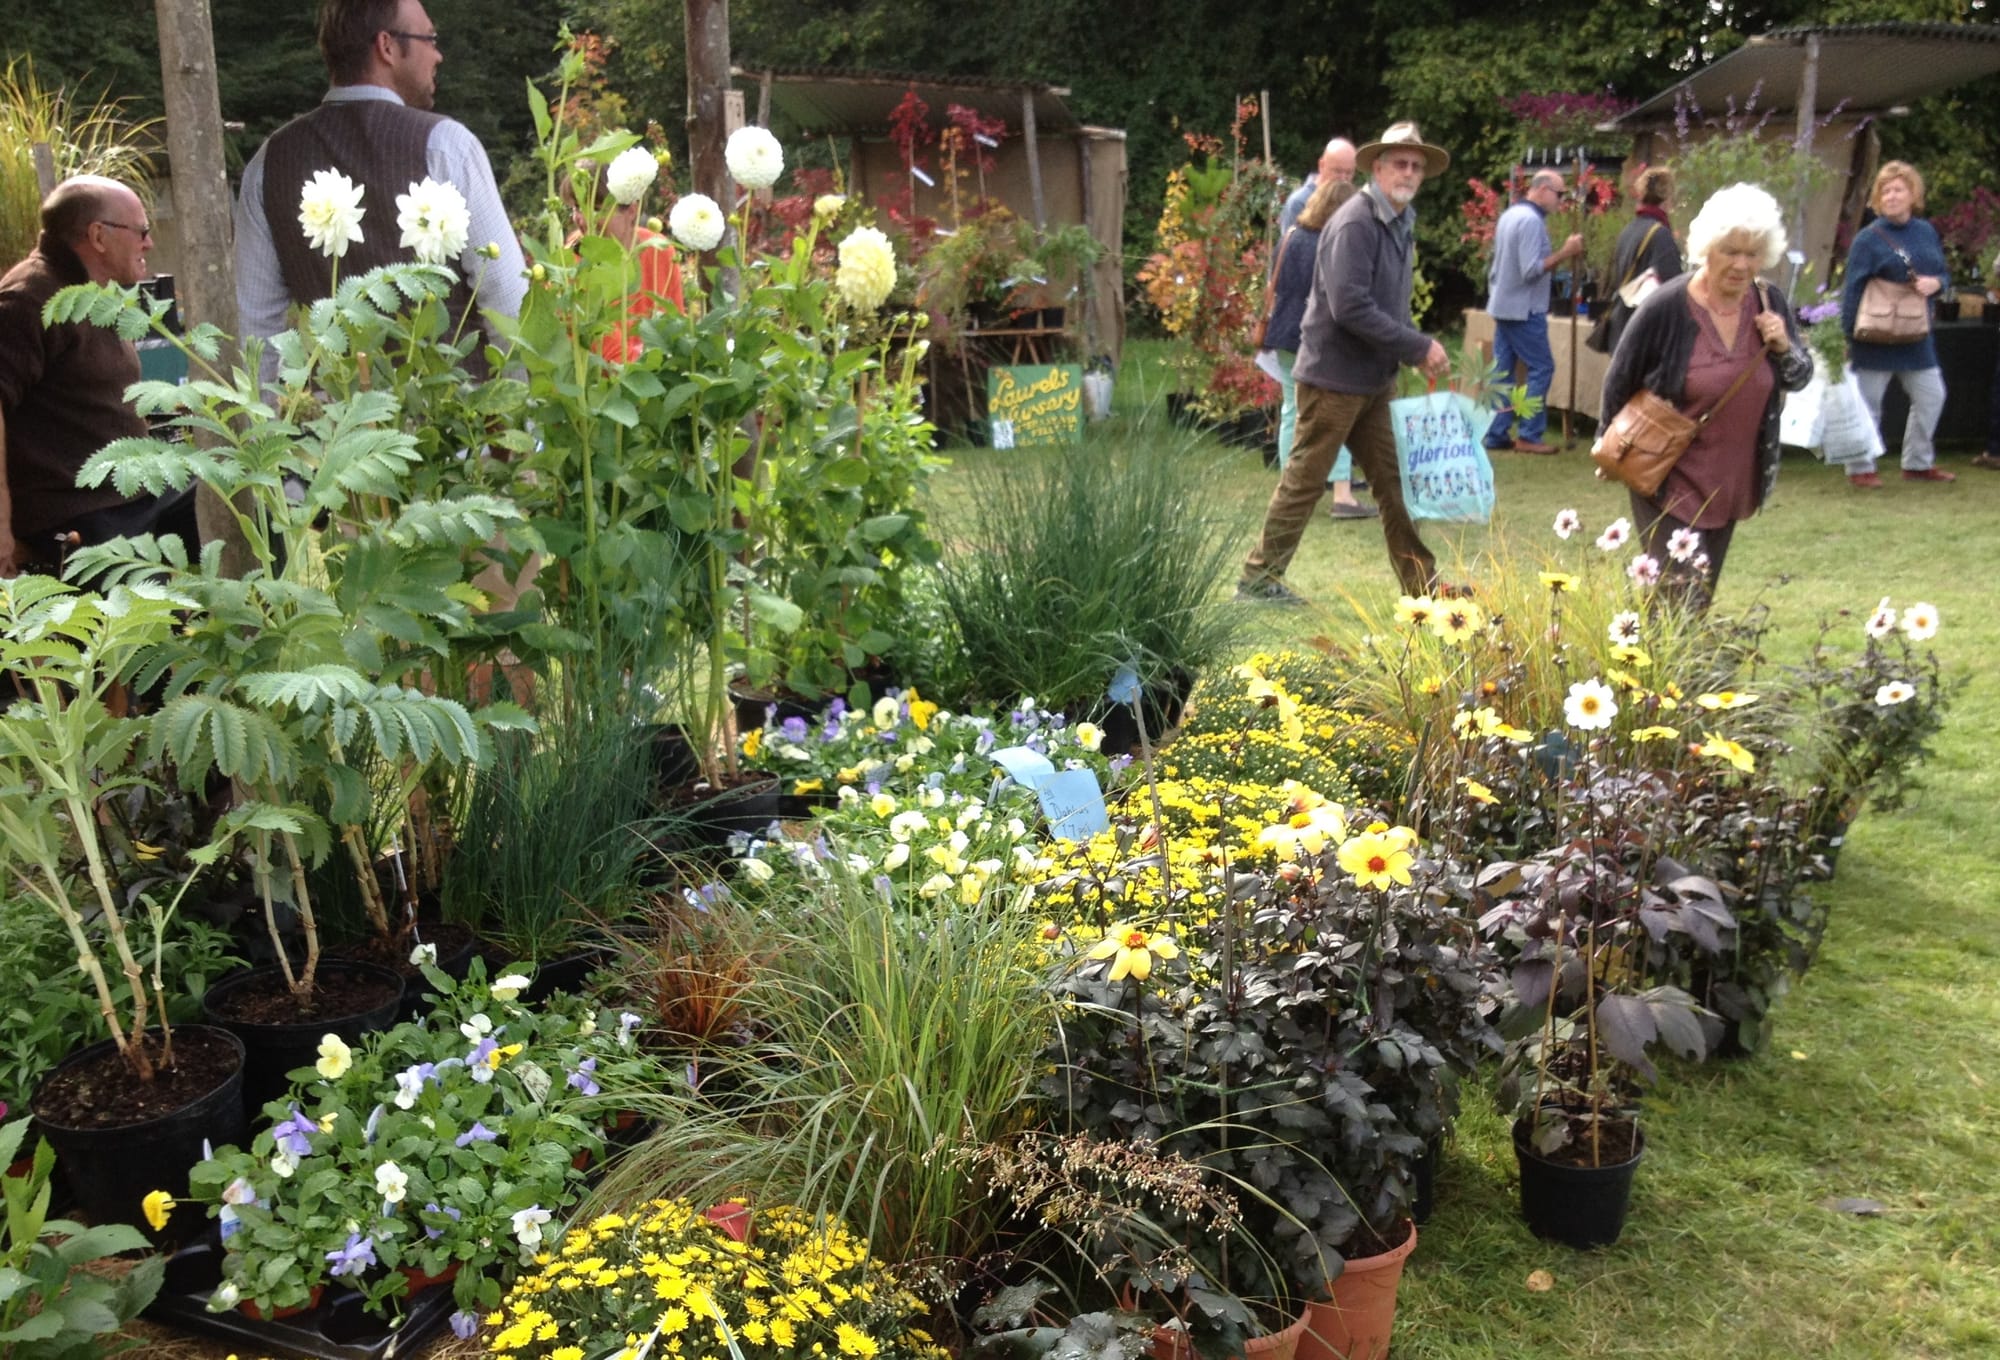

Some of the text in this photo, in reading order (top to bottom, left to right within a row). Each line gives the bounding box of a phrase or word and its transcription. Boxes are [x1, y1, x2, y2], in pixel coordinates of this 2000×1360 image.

[988, 368, 1070, 413] Laurels
[1000, 387, 1080, 420] Nursery
[1409, 442, 1475, 471] gloriou
